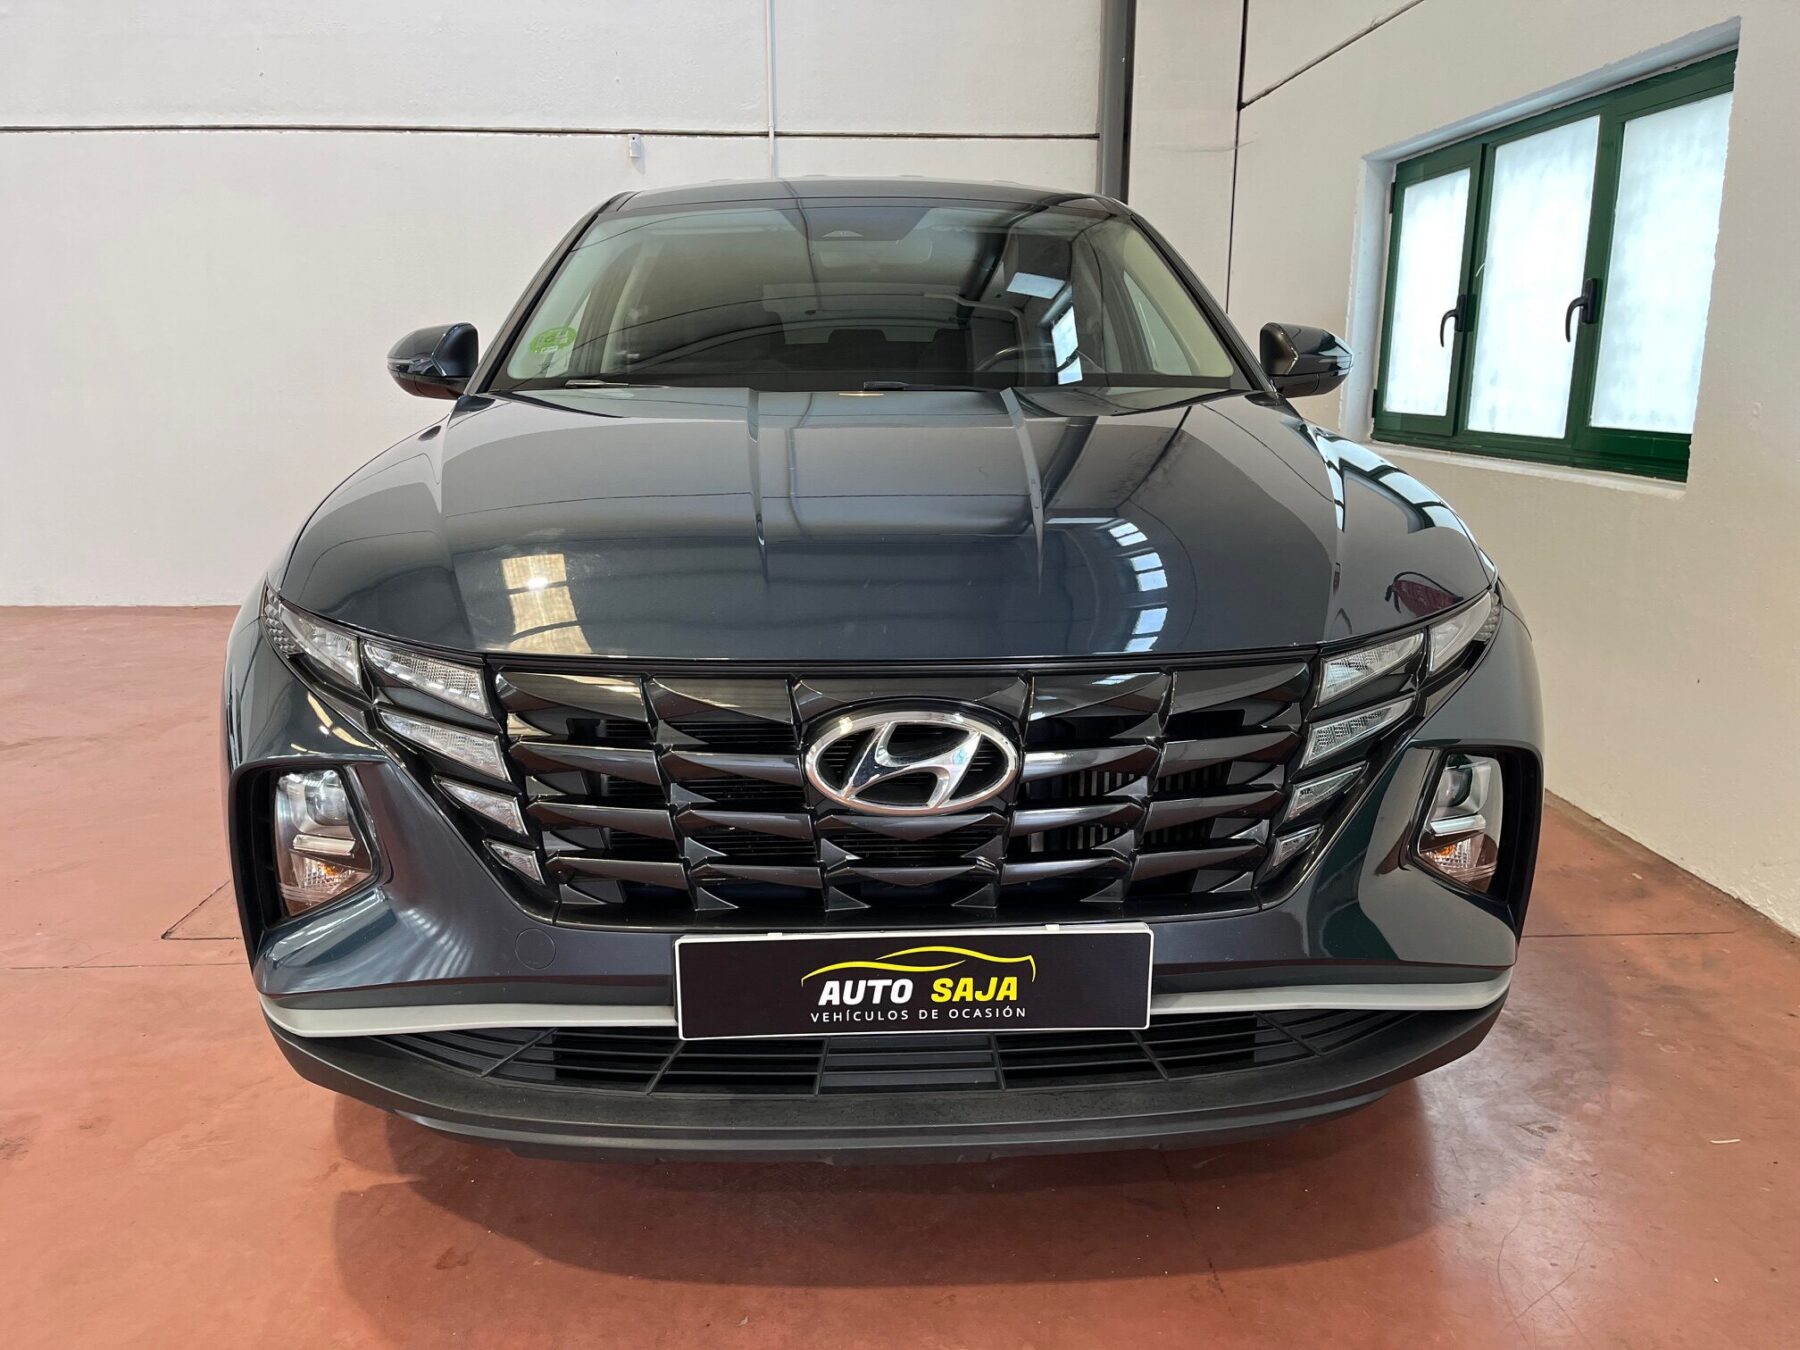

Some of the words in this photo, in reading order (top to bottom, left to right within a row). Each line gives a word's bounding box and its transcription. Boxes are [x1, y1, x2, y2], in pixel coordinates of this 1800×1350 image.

[817, 978, 914, 1006] AUTO
[930, 976, 1018, 1003] SAJA
[810, 1009, 909, 1023] VEHÍCULOS
[918, 1009, 939, 1020] DE
[948, 1005, 1026, 1019] OCASIÓN
